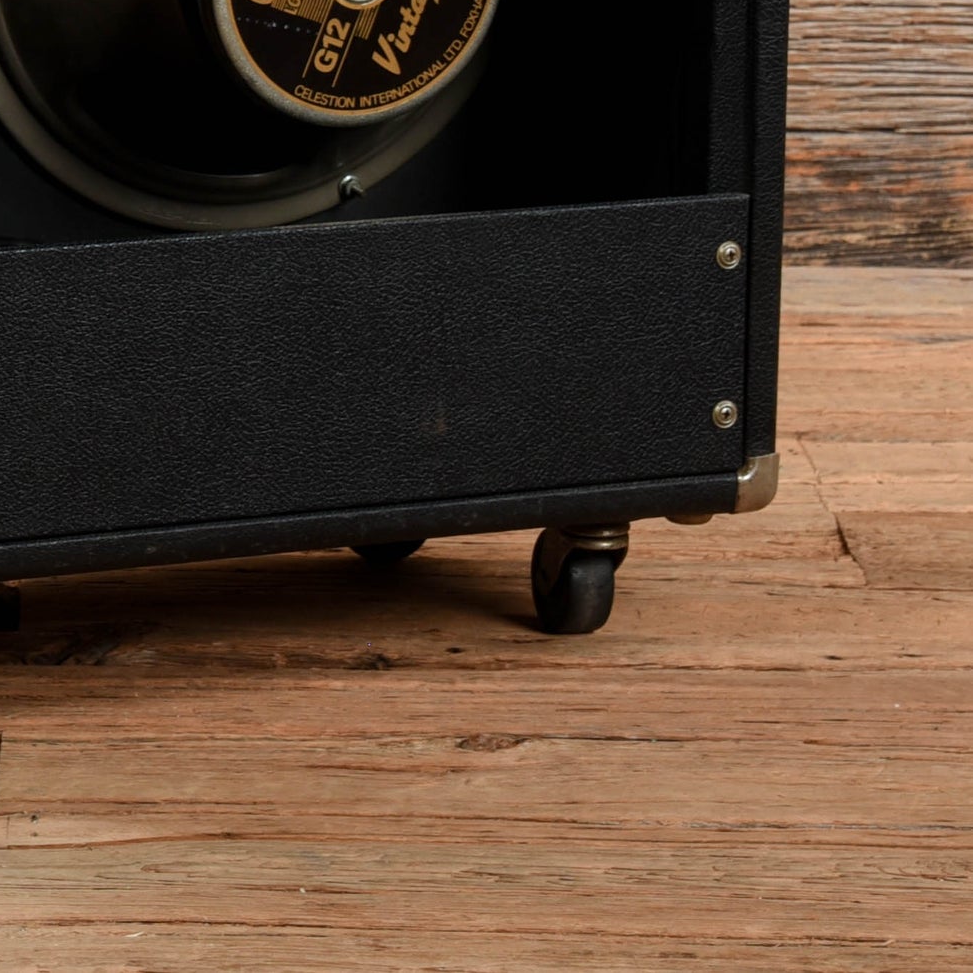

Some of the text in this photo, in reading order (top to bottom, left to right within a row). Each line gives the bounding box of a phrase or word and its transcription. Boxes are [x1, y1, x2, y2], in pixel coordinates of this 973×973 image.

[313, 17, 350, 75] G12
[294, 84, 355, 108] CELESTION
[360, 57, 445, 107] INTERNATIONAL
